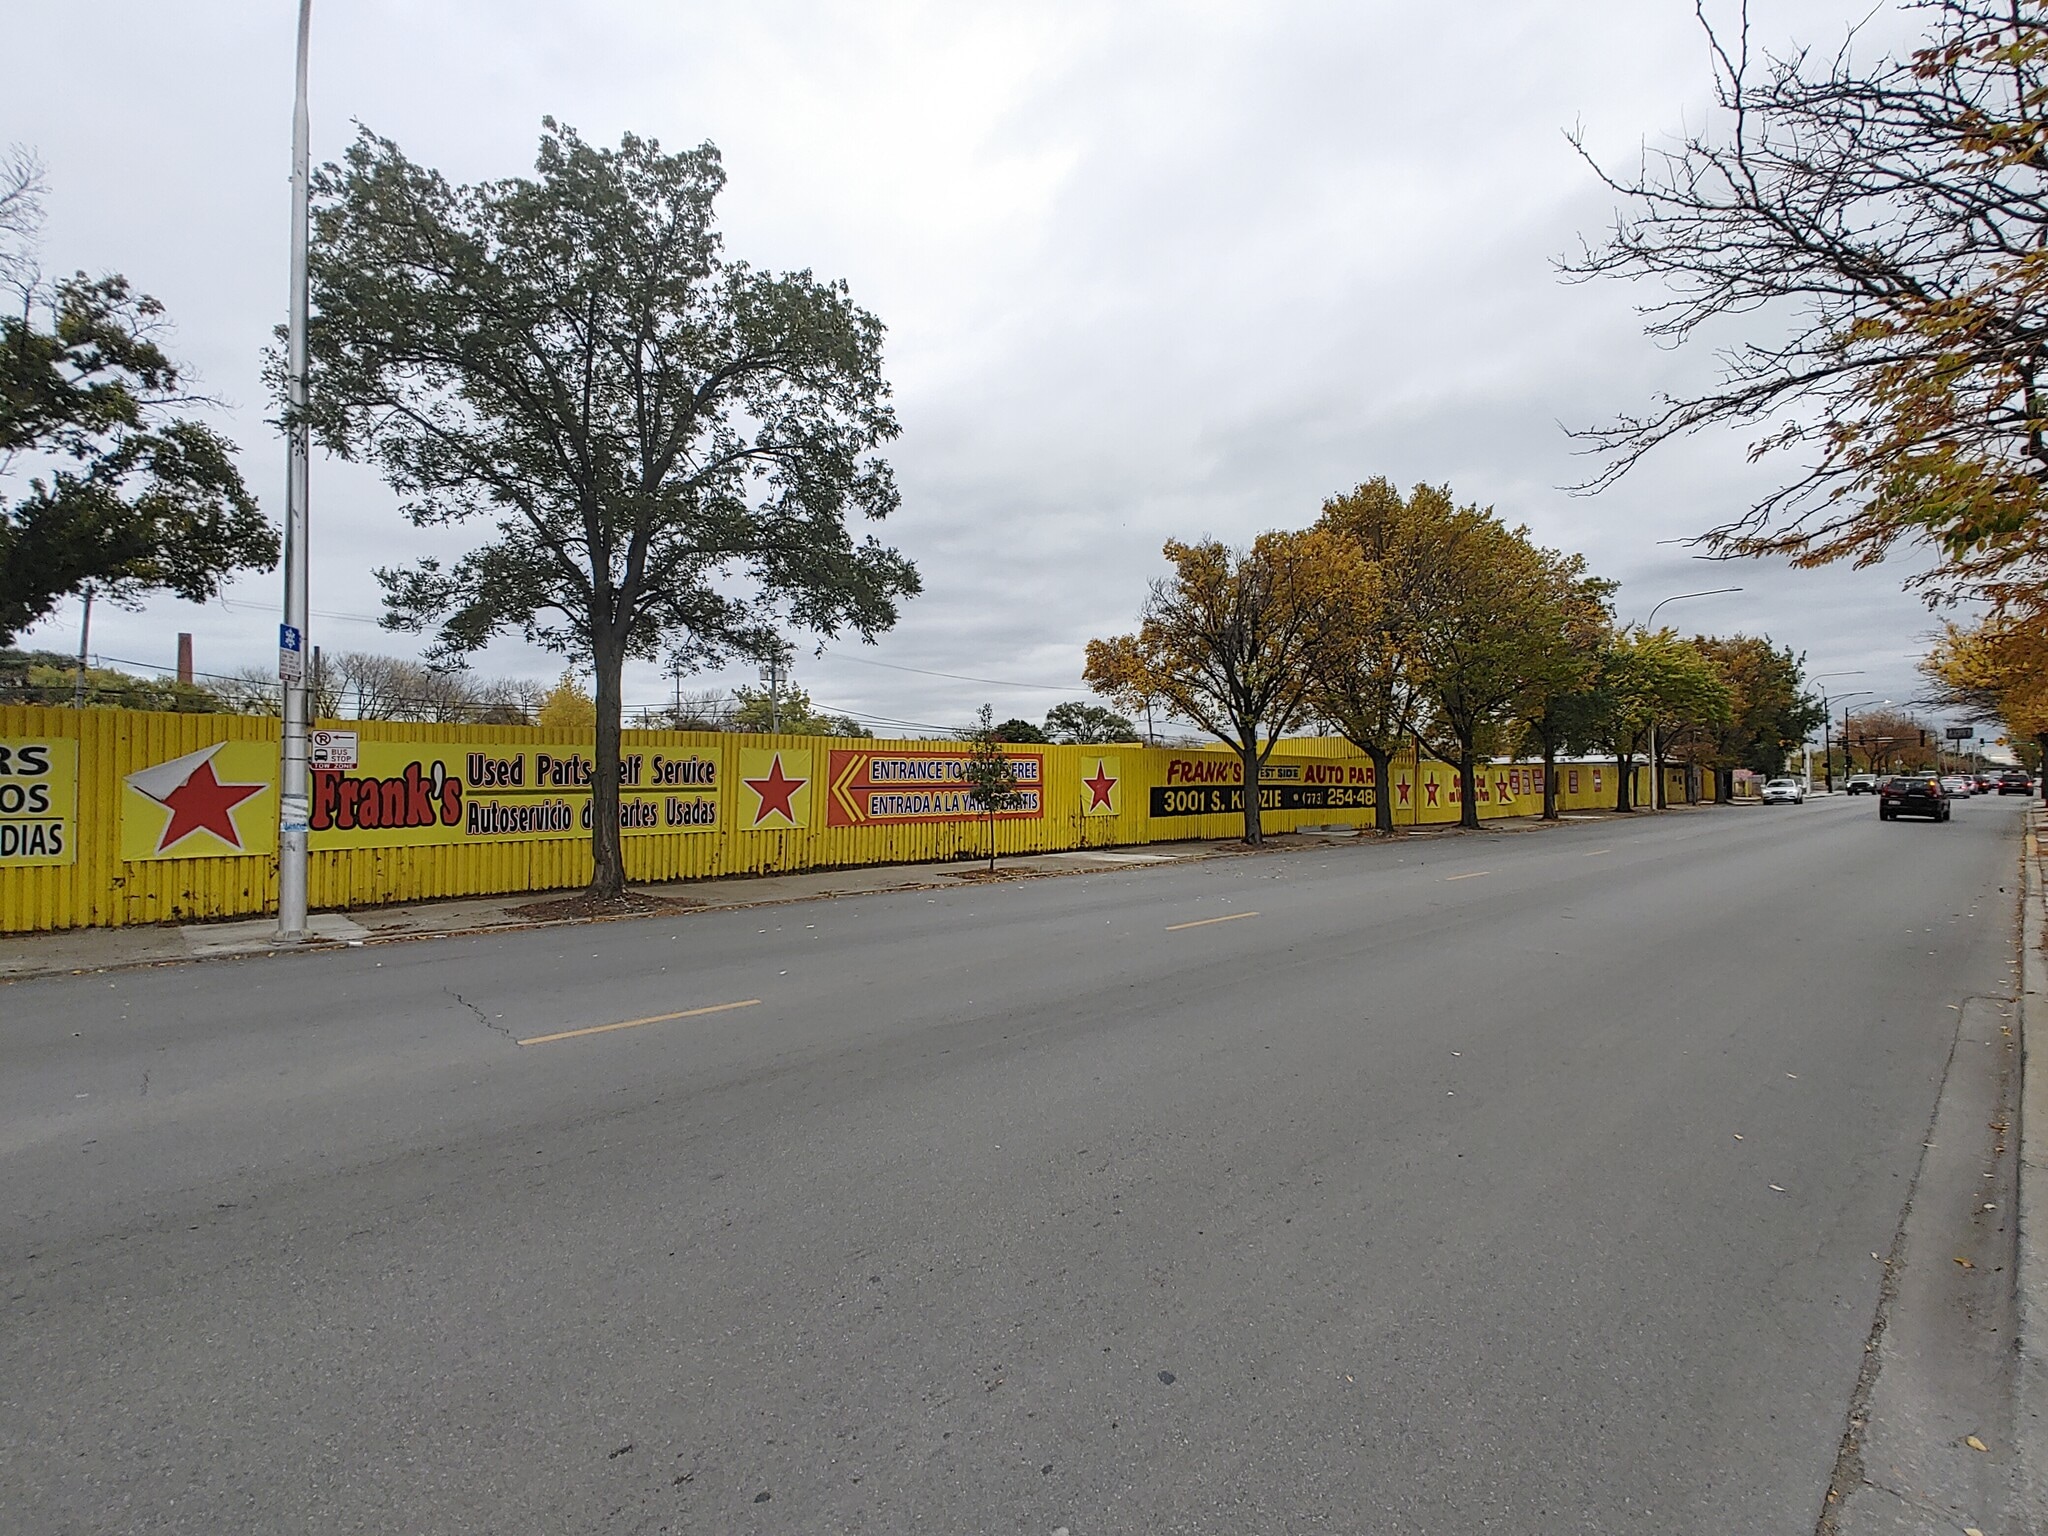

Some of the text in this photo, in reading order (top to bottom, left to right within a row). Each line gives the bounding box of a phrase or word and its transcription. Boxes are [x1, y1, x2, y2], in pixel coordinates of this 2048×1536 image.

[331, 755, 352, 763] STOP
[466, 752, 716, 788] Used Parts elf Service
[872, 761, 943, 779] ENTRANCE
[945, 761, 962, 779] TO
[1011, 762, 1038, 779] FREE
[1167, 759, 1375, 785] FRANK'S EST SIDE AUTO PAR
[309, 760, 463, 831] Frank's
[871, 796, 931, 815] ENTRADA
[934, 795, 943, 813] A
[945, 795, 960, 812] LA
[1164, 789, 1206, 812] 3001
[1211, 790, 1225, 811] S.
[1231, 789, 1281, 809] KZIE
[466, 796, 717, 836] Autoservicio d artes Usadas
[0, 824, 63, 857] DIAS
